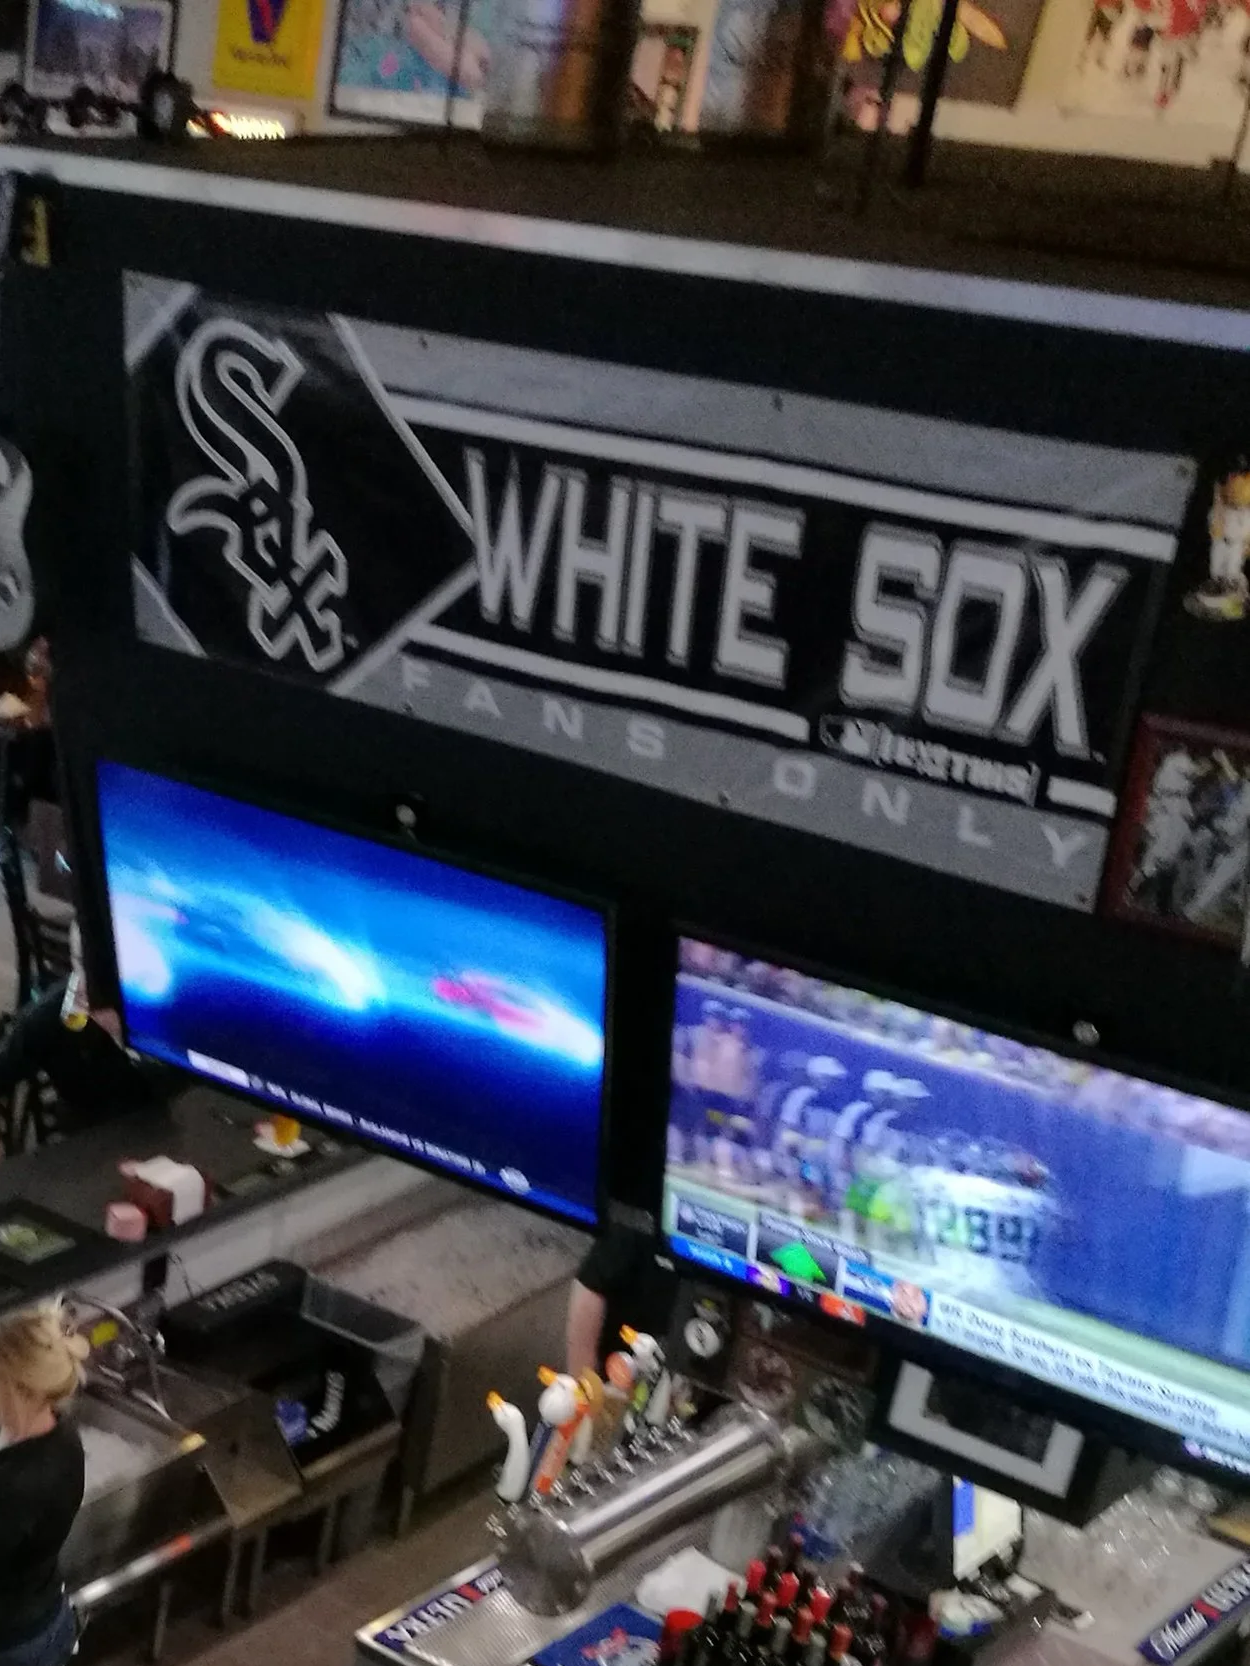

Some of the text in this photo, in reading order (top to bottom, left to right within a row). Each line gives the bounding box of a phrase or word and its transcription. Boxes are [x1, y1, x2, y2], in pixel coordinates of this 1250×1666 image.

[464, 446, 1130, 762] WHITE SOX
[401, 656, 667, 761] FANS
[772, 755, 1088, 870] ONLY
